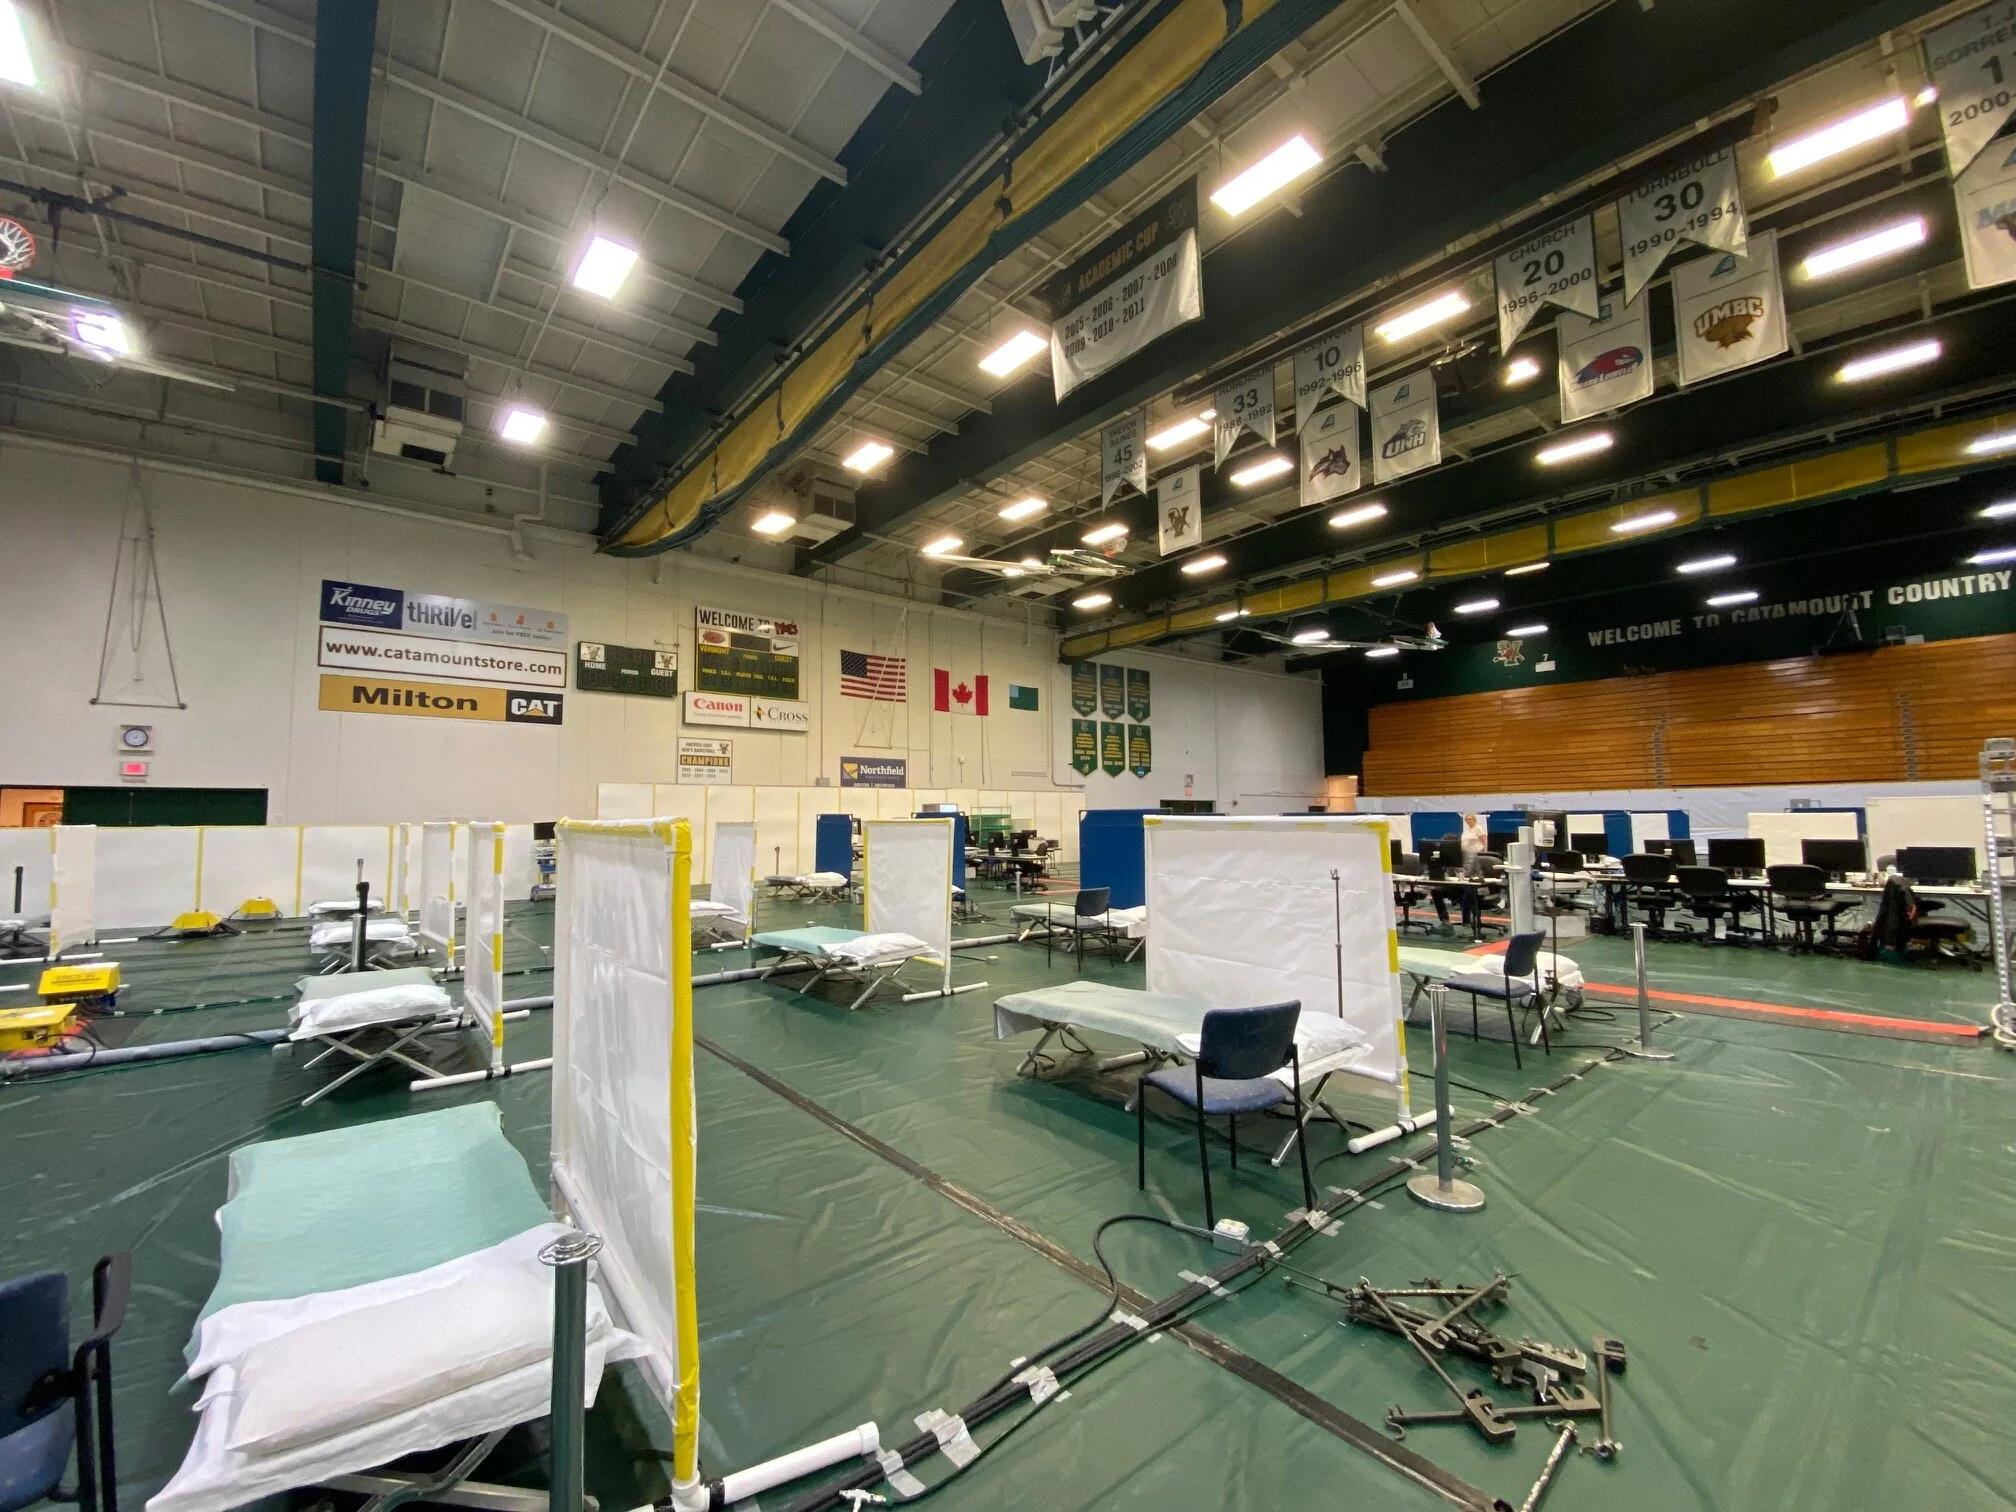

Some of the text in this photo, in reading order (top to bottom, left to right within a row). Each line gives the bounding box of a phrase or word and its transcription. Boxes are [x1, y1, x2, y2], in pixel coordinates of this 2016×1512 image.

[1653, 180, 1704, 222] 30
[1509, 223, 1576, 263] CHURCH
[1628, 201, 1738, 258] 1990-1994
[1079, 221, 1159, 294] ACADEMIC CUP
[1522, 249, 1565, 287] 20
[1122, 274, 1145, 302] 2007
[1502, 267, 1592, 315] 1996-2000
[1092, 317, 1114, 343] 2010
[1122, 298, 1145, 324] 2011
[1694, 296, 1764, 338] UMBC
[1314, 345, 1341, 372] 10
[1297, 361, 1362, 397] 1992-1996
[1233, 388, 1259, 414] 33
[1113, 444, 1133, 465] 45
[1382, 430, 1426, 460] UNH
[330, 586, 396, 616] Kinney
[345, 606, 381, 616] DRUGS
[1588, 570, 2012, 647] WELCOME TO CATAMOUNT COUNTRY
[699, 609, 755, 632] WELCOME
[325, 641, 563, 676] www.catamountstore.com
[699, 644, 730, 655] VERMONT
[584, 661, 607, 670] HOME
[650, 668, 674, 677] GUEST
[351, 685, 479, 712] Milton
[510, 697, 560, 718] CAT
[693, 698, 743, 713] Canon
[767, 706, 809, 723] CROSS
[681, 755, 730, 767] CHAMPIONS
[859, 764, 905, 776] Northfield
